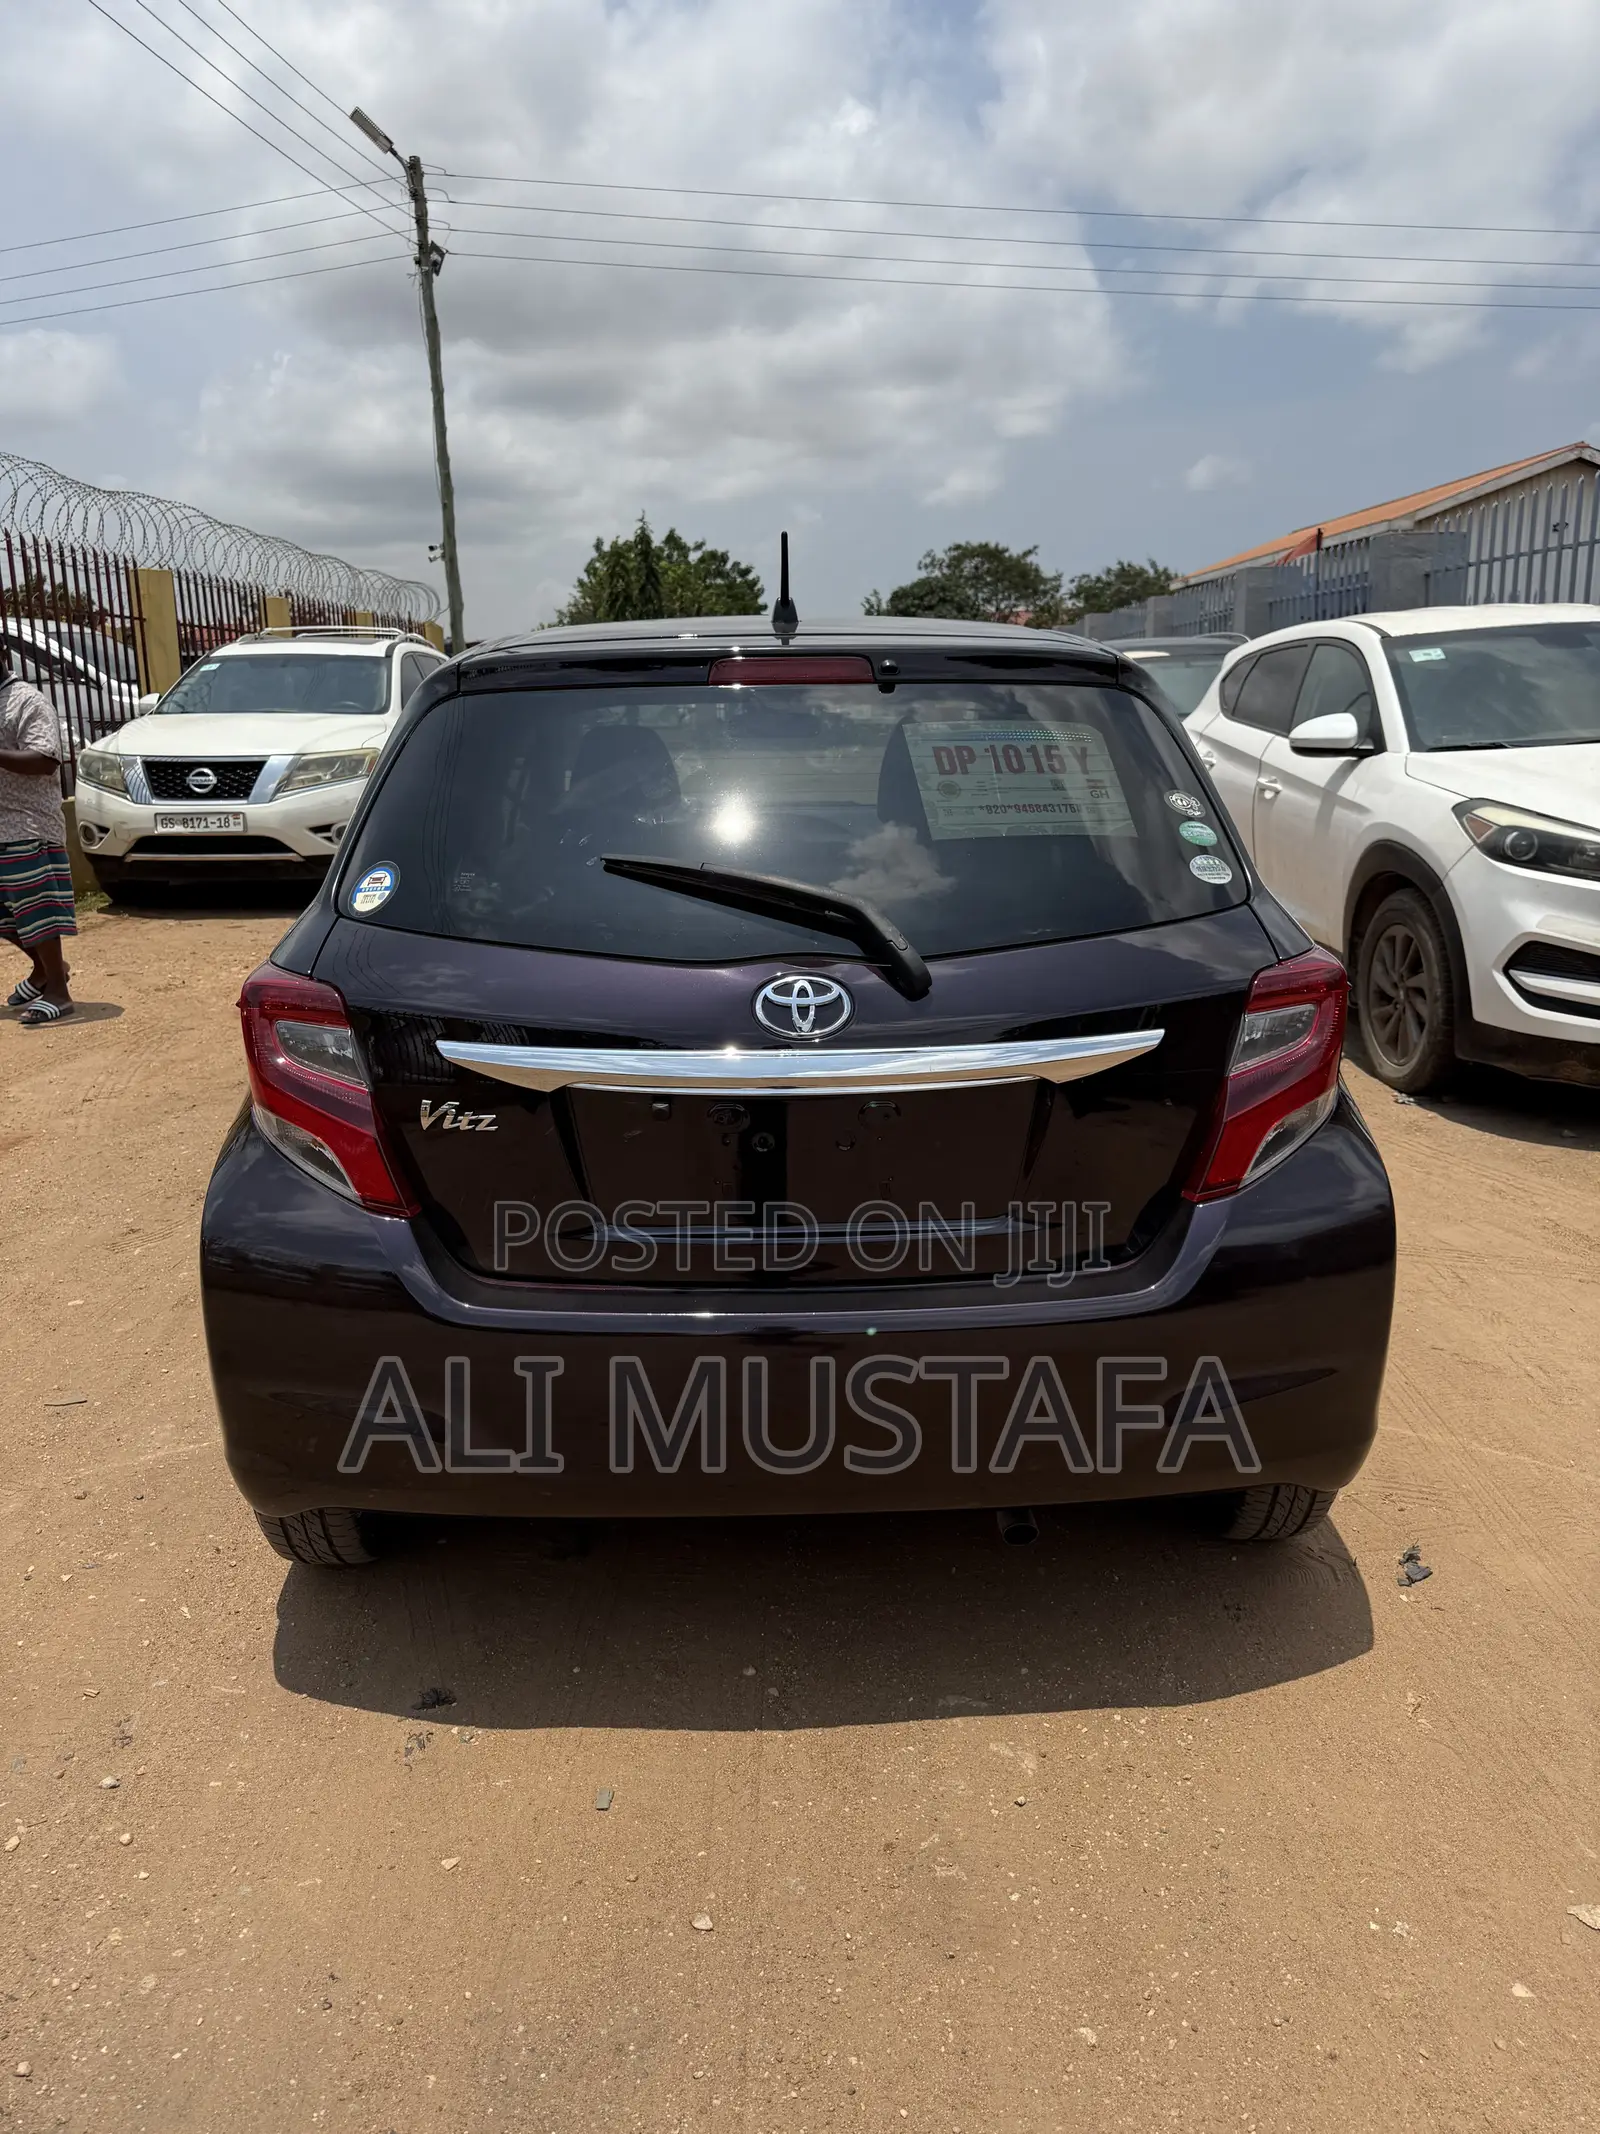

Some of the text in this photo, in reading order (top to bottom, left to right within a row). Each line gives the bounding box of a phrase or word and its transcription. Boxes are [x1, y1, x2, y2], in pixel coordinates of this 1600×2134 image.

[931, 742, 1090, 775] DP 1015 Y
[1089, 789, 1111, 799] GH
[160, 815, 231, 829] GS 8171-18
[420, 1099, 498, 1131] Vitz
